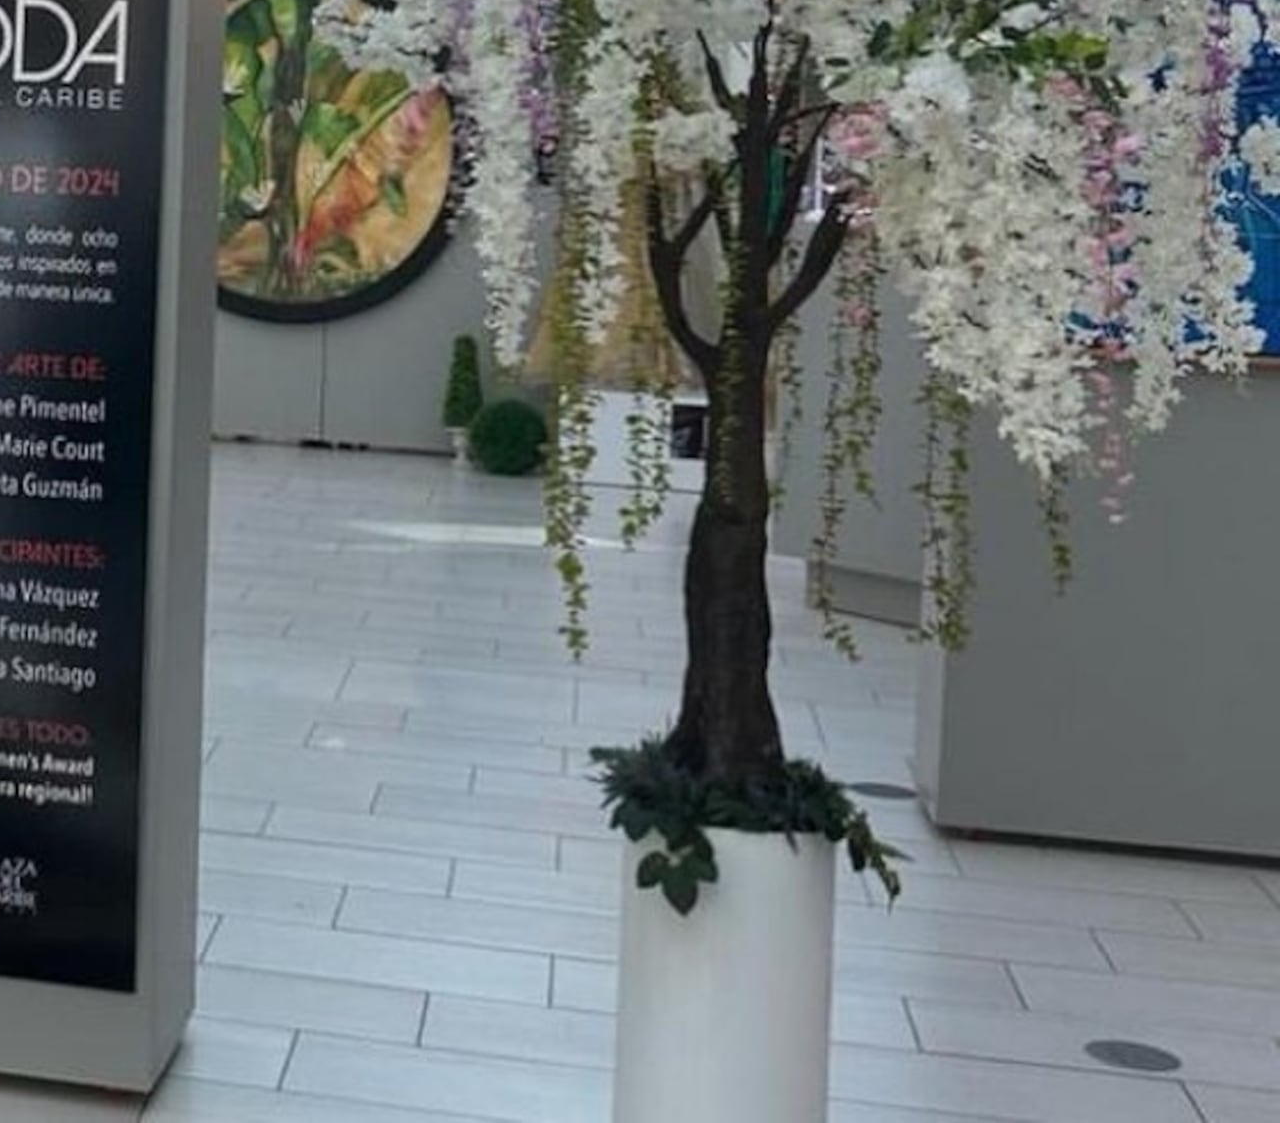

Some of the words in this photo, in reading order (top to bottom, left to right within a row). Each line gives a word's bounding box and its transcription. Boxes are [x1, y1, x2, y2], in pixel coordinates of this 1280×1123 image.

[15, 87, 124, 109] CARIBE
[12, 164, 48, 194] DE
[57, 167, 119, 196] 2024
[26, 224, 73, 245] donde
[82, 227, 119, 247] ocho
[18, 253, 93, 275] inspirados
[96, 259, 117, 275] en
[15, 282, 70, 301] manera
[8, 352, 64, 377] ARTE
[20, 395, 106, 423] Pimentel
[51, 435, 106, 462] Court
[22, 472, 103, 501] Guzmán
[20, 578, 100, 612] Vázquez
[11, 656, 97, 692] Santiago
[42, 752, 94, 776] Award
